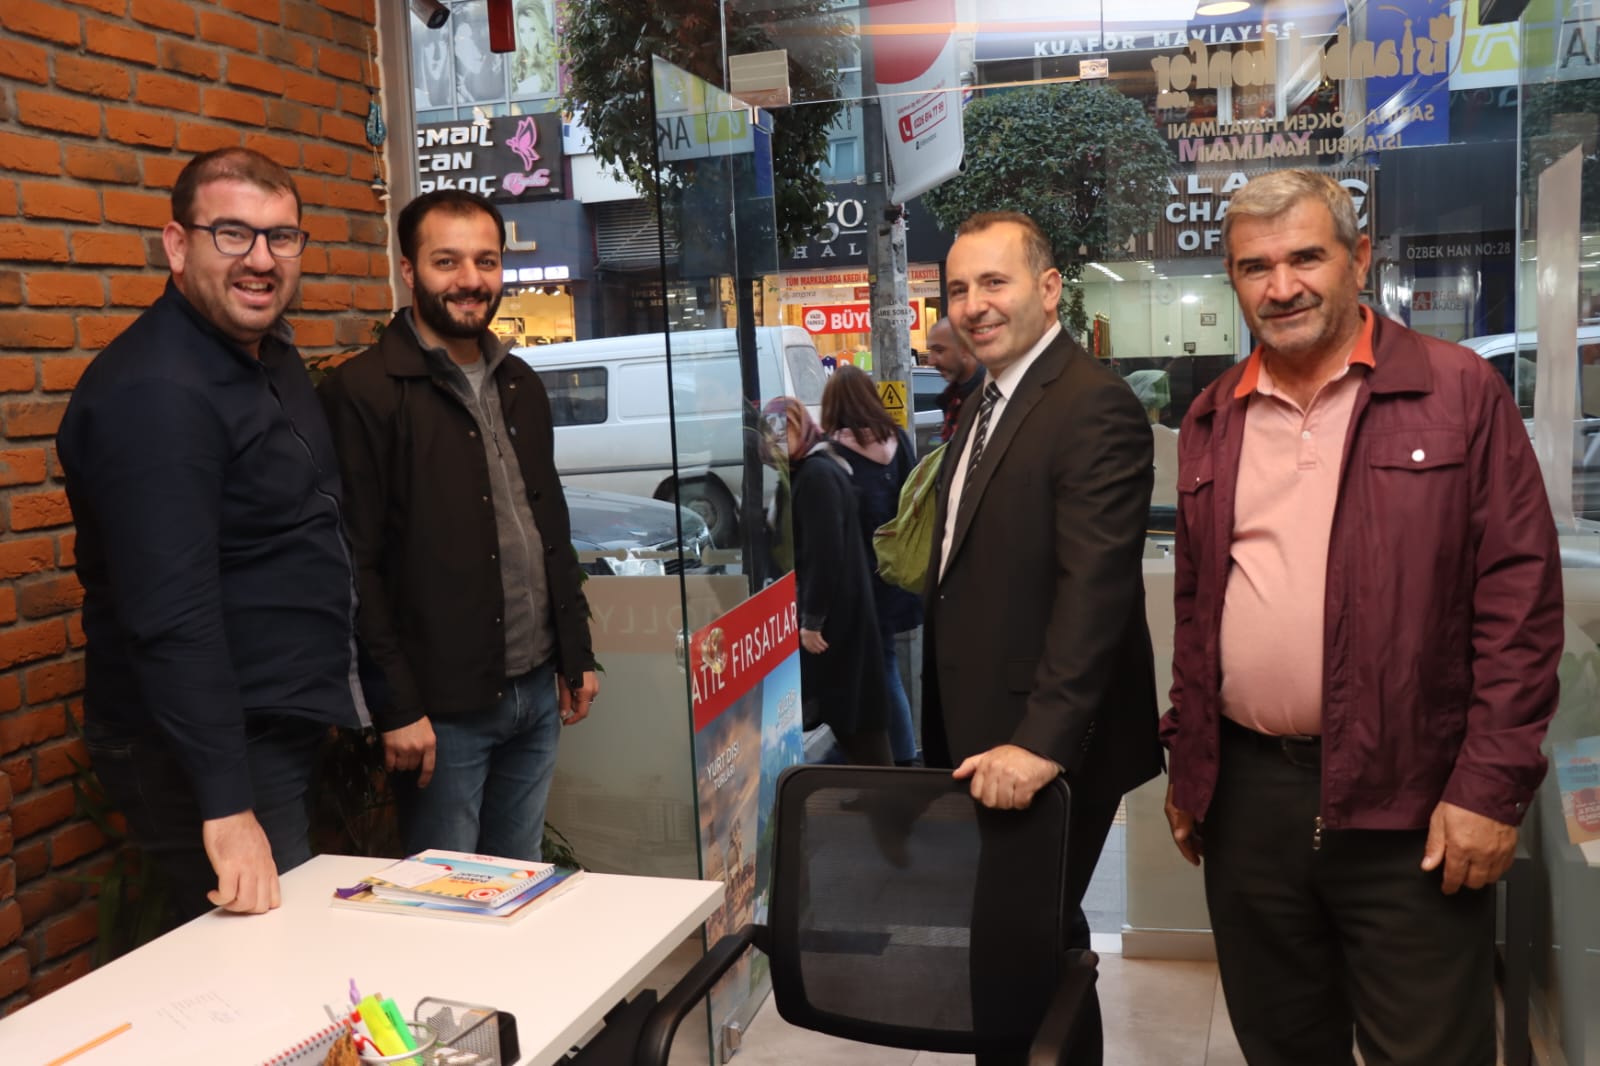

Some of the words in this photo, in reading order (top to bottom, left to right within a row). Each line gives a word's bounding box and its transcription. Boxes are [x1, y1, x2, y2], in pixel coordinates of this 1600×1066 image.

[1034, 33, 1136, 57] KUAFÖR
[1406, 243, 1444, 260] ÖZBEK
[1447, 243, 1472, 258] HAN
[1475, 241, 1511, 256] NO:28
[707, 752, 727, 781] YURT
